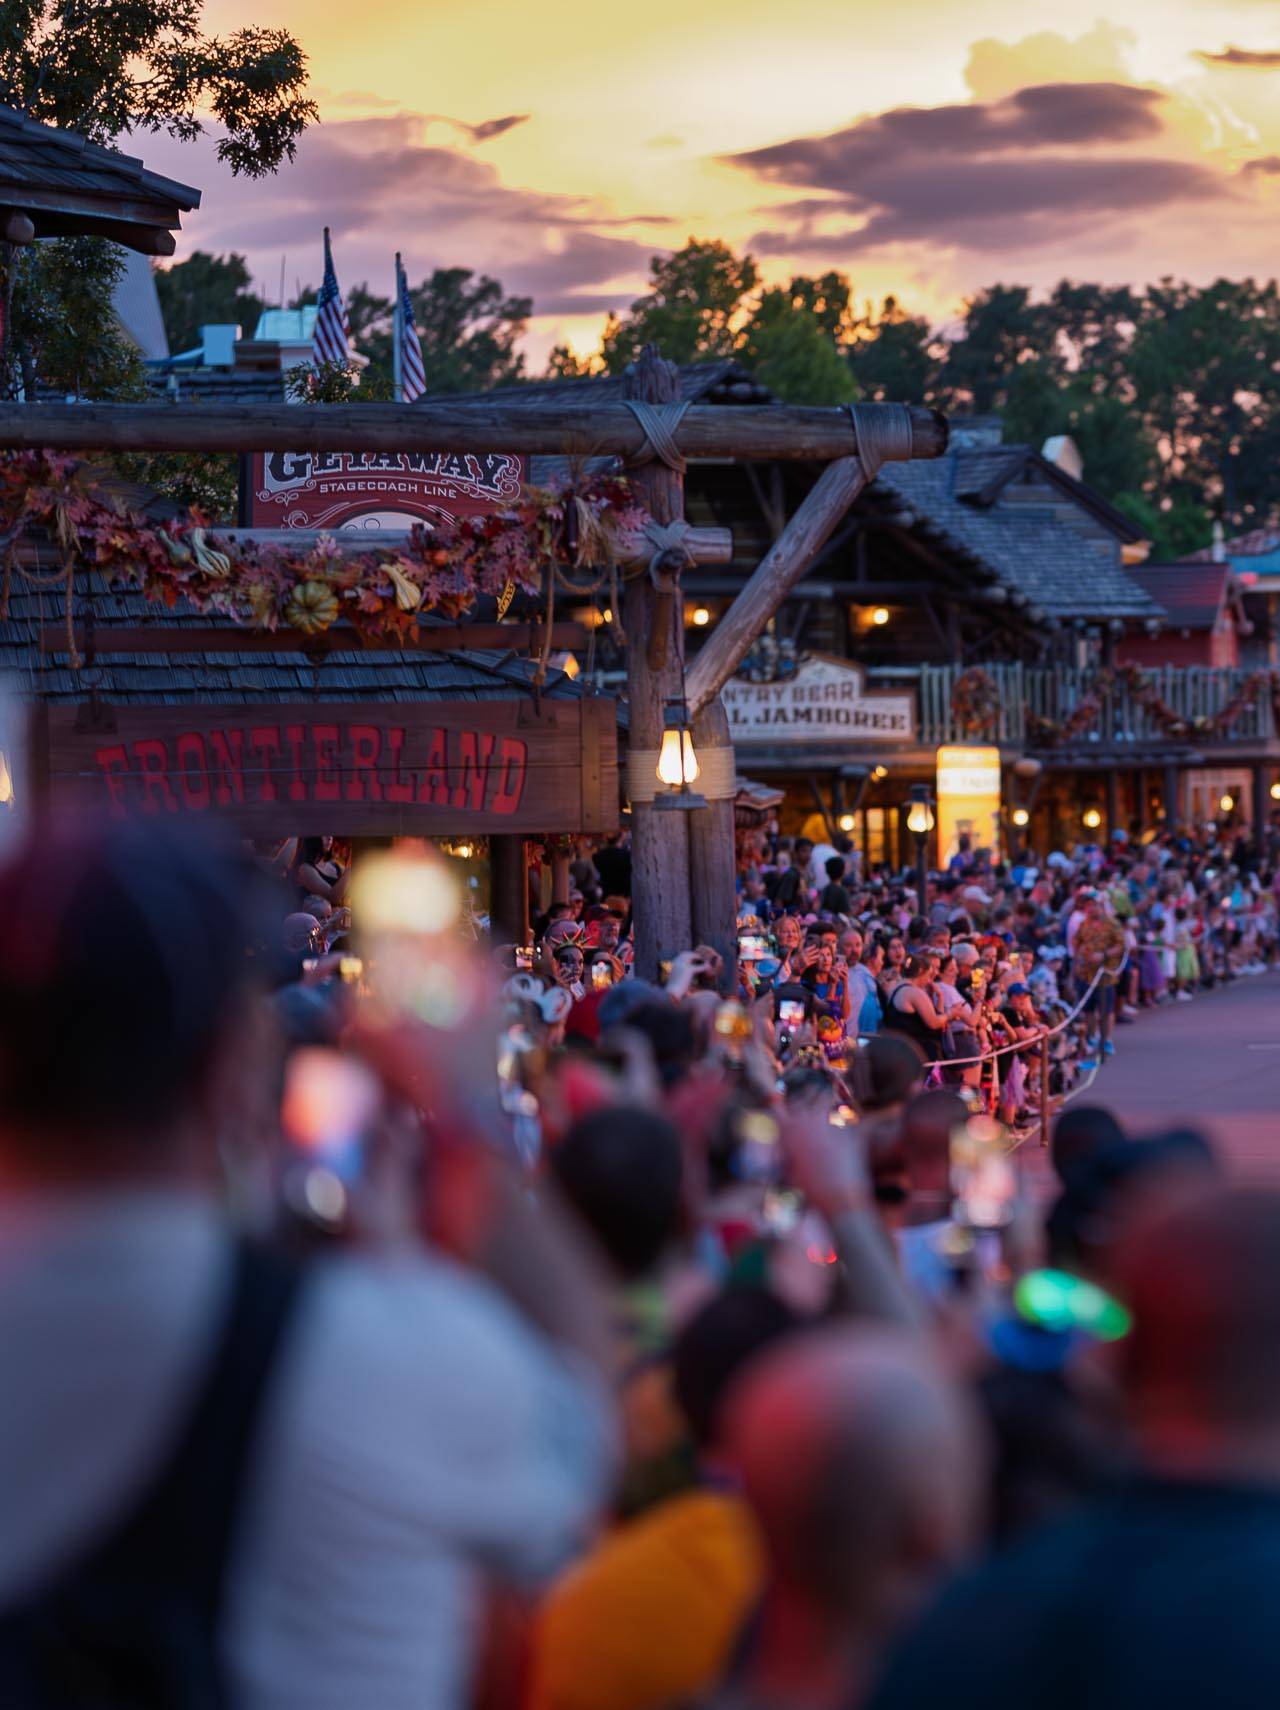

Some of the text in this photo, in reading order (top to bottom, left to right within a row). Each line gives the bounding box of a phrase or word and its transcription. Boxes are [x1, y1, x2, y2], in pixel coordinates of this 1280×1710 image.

[265, 452, 510, 493] GETAWAY
[319, 481, 457, 499] STAGECOACH LINE
[724, 681, 854, 703] NTRY BEAR
[756, 707, 905, 731] JAMBOREE
[96, 723, 529, 818] FRONTIERLAND
